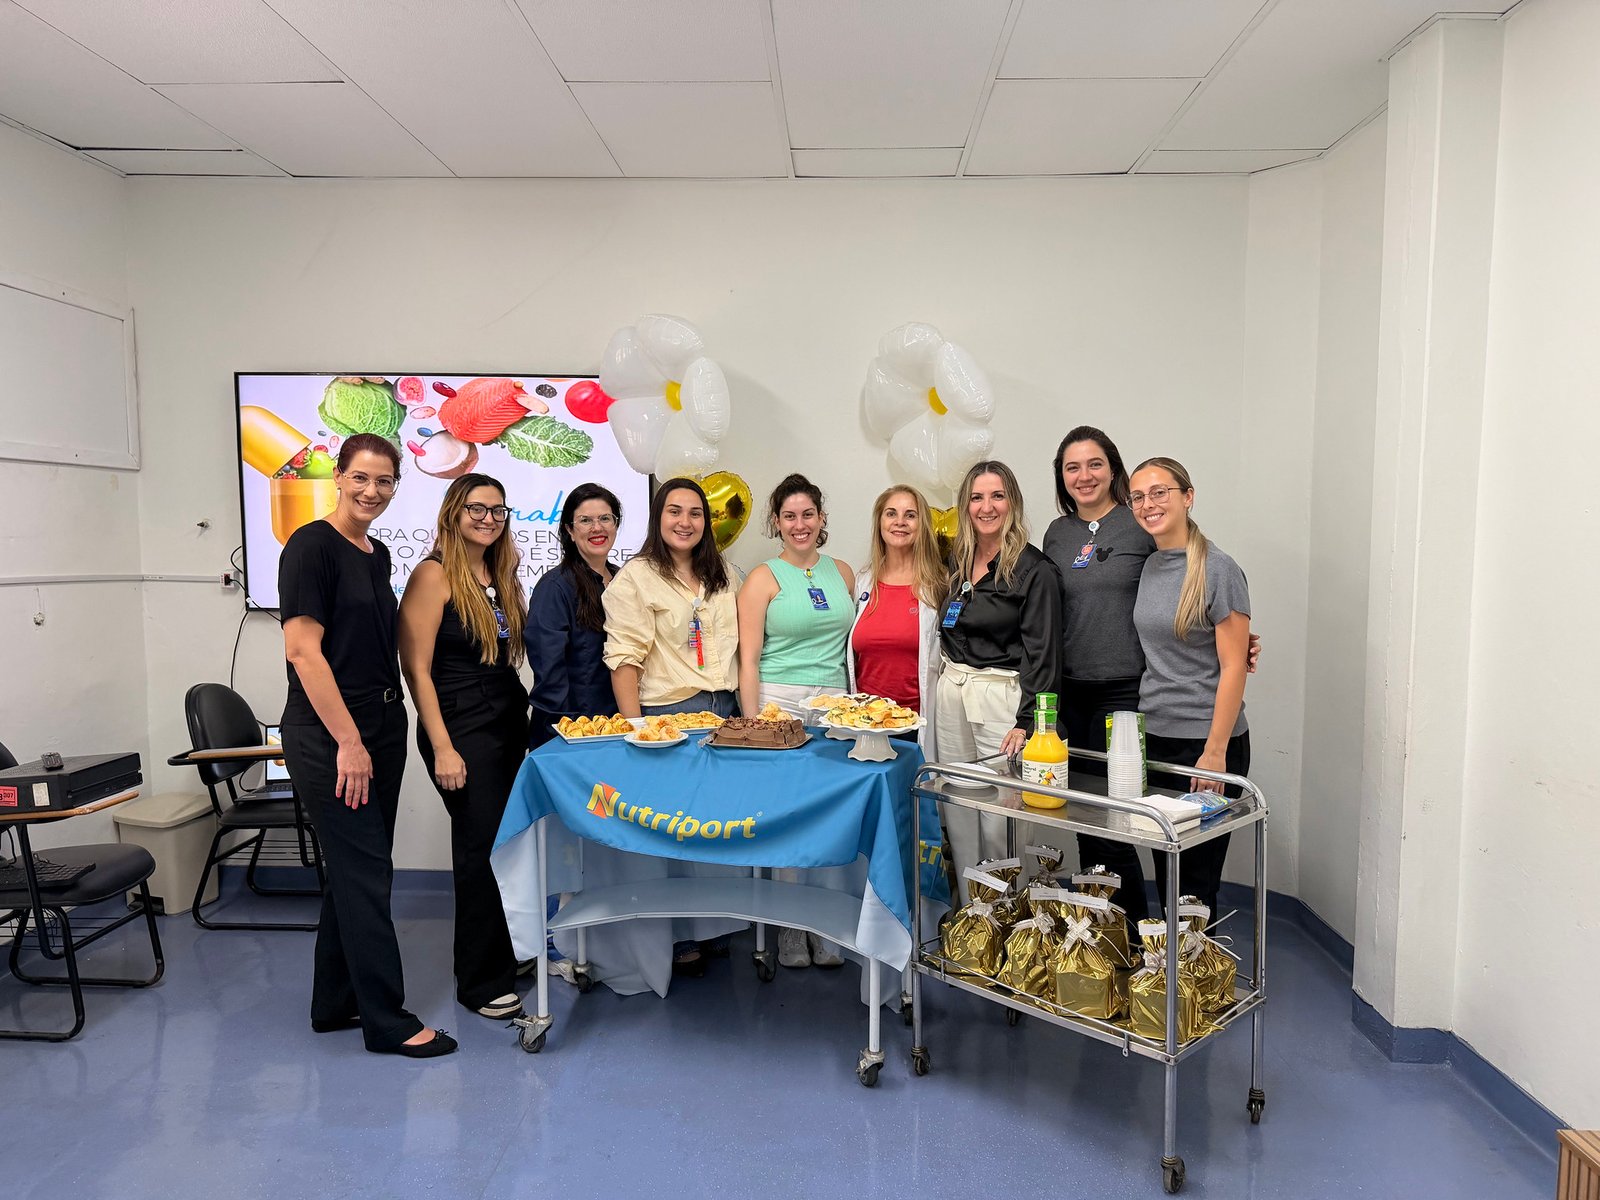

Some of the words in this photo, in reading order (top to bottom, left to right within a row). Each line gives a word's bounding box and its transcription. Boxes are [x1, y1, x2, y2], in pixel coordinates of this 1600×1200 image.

[511, 490, 563, 525] rab
[530, 543, 543, 561] É
[586, 783, 757, 842] Nutriport
